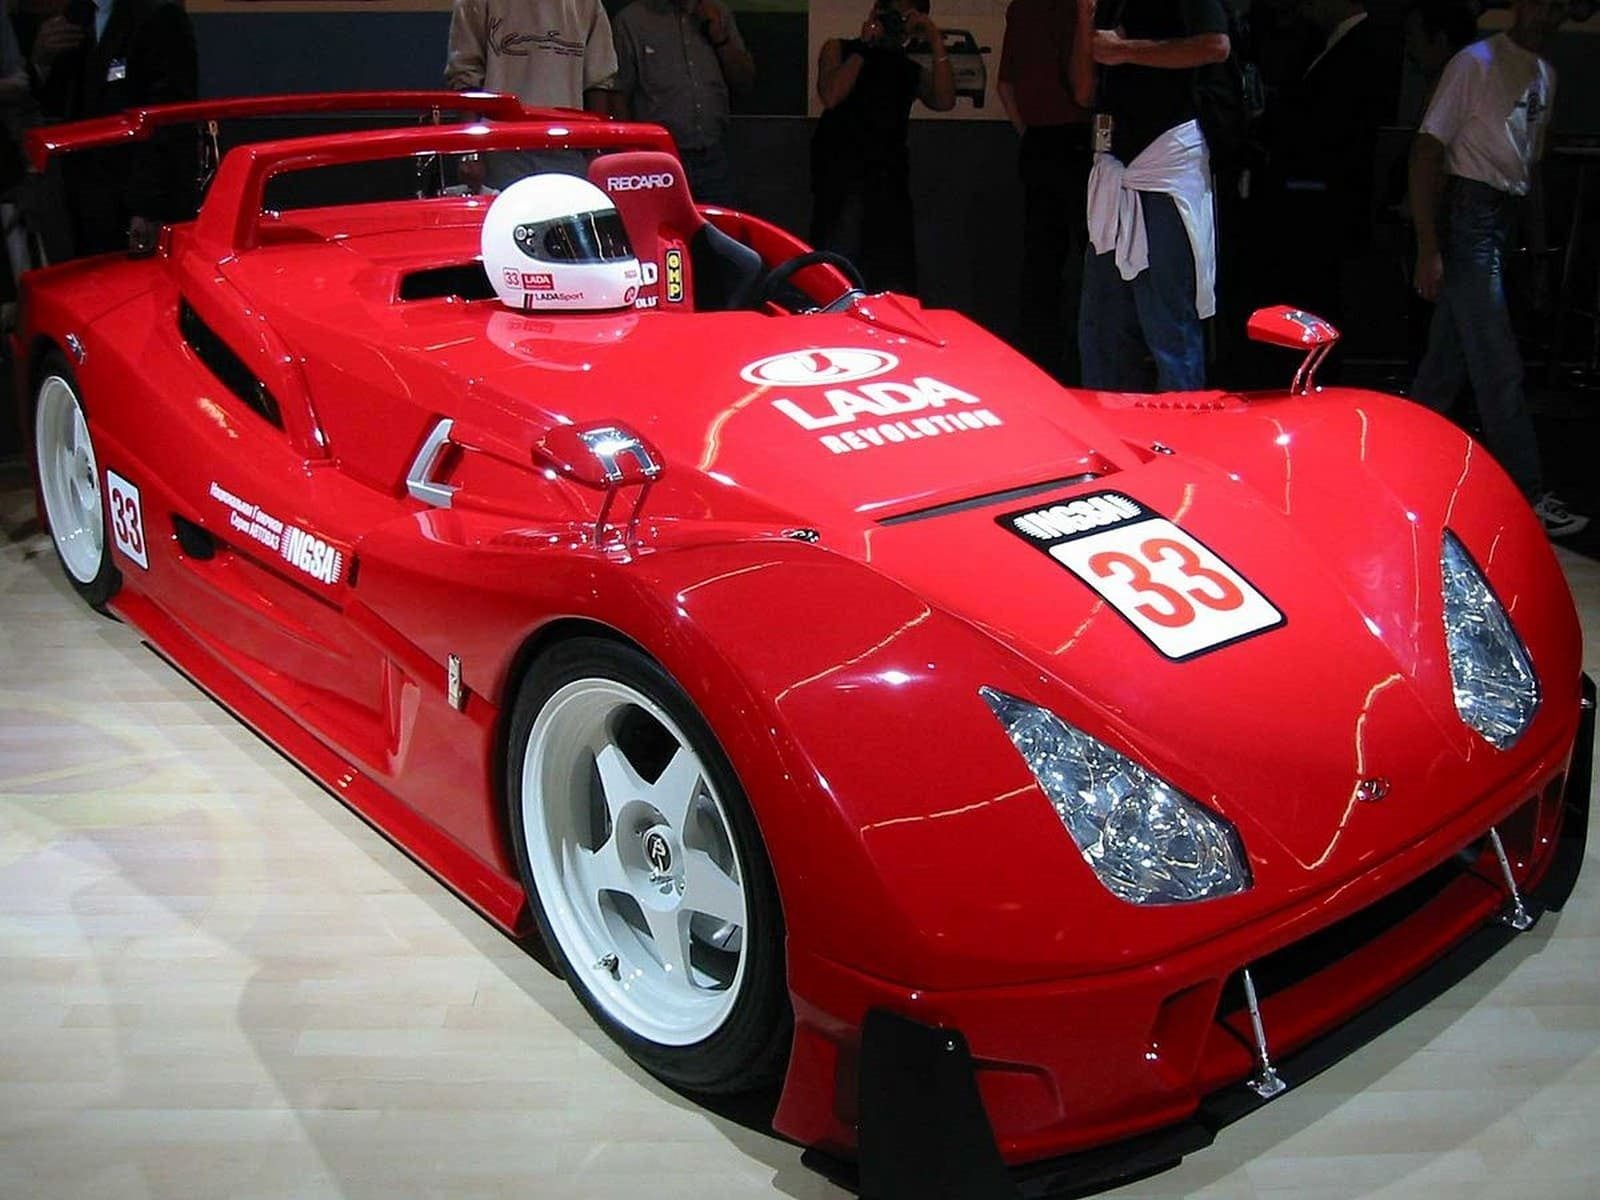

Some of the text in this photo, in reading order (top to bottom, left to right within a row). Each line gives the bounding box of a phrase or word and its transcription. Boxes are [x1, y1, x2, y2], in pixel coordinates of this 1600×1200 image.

[607, 173, 674, 192] RECARO
[504, 270, 519, 287] 33
[524, 274, 551, 285] LADA
[771, 377, 981, 430] LADA
[819, 409, 1003, 454] REVOLUTION
[112, 488, 142, 554] 33
[285, 527, 337, 585] NGSA
[1088, 538, 1244, 628] 33
